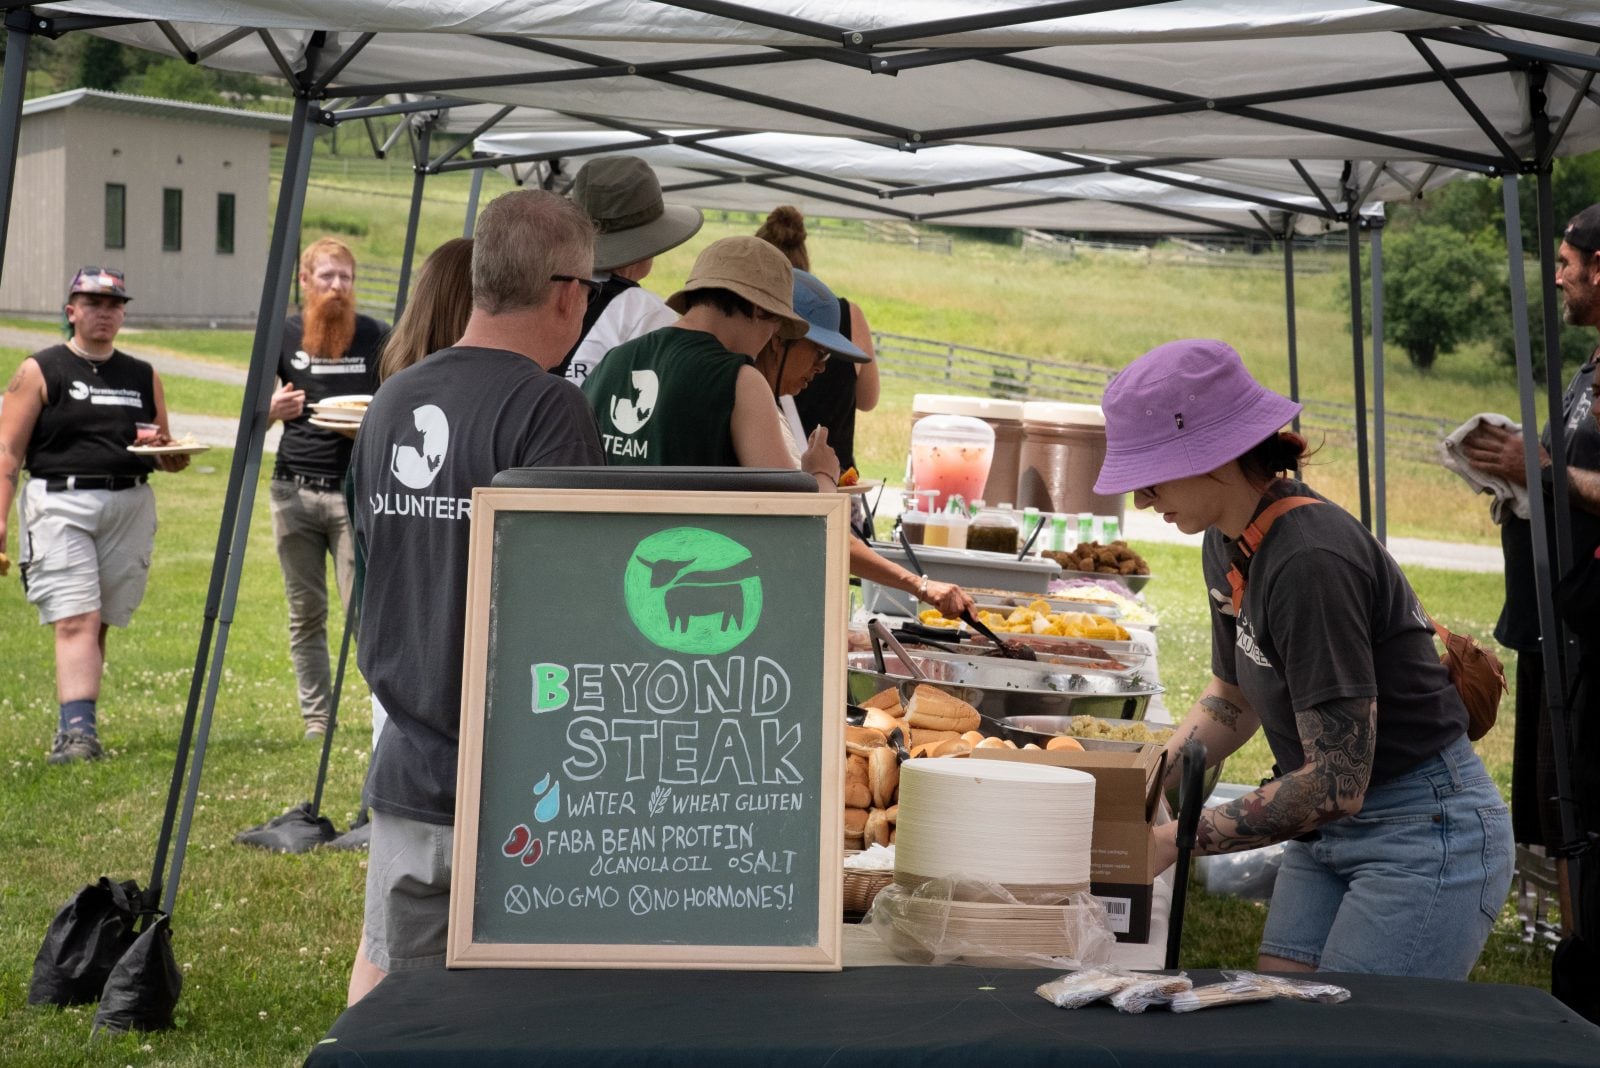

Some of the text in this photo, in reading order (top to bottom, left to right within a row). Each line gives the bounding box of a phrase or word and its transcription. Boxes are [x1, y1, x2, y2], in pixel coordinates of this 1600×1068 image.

[602, 433, 648, 459] TEAM
[531, 656, 791, 716] BEYOND
[562, 716, 804, 786] STEAK
[567, 791, 803, 818] WATER WHEAT GLUTEN
[547, 822, 754, 856] FABA BEAN PROTEIN
[604, 850, 798, 875] CANOLA OIL SALT
[532, 883, 794, 911] NO GMO NO HORMONES!
